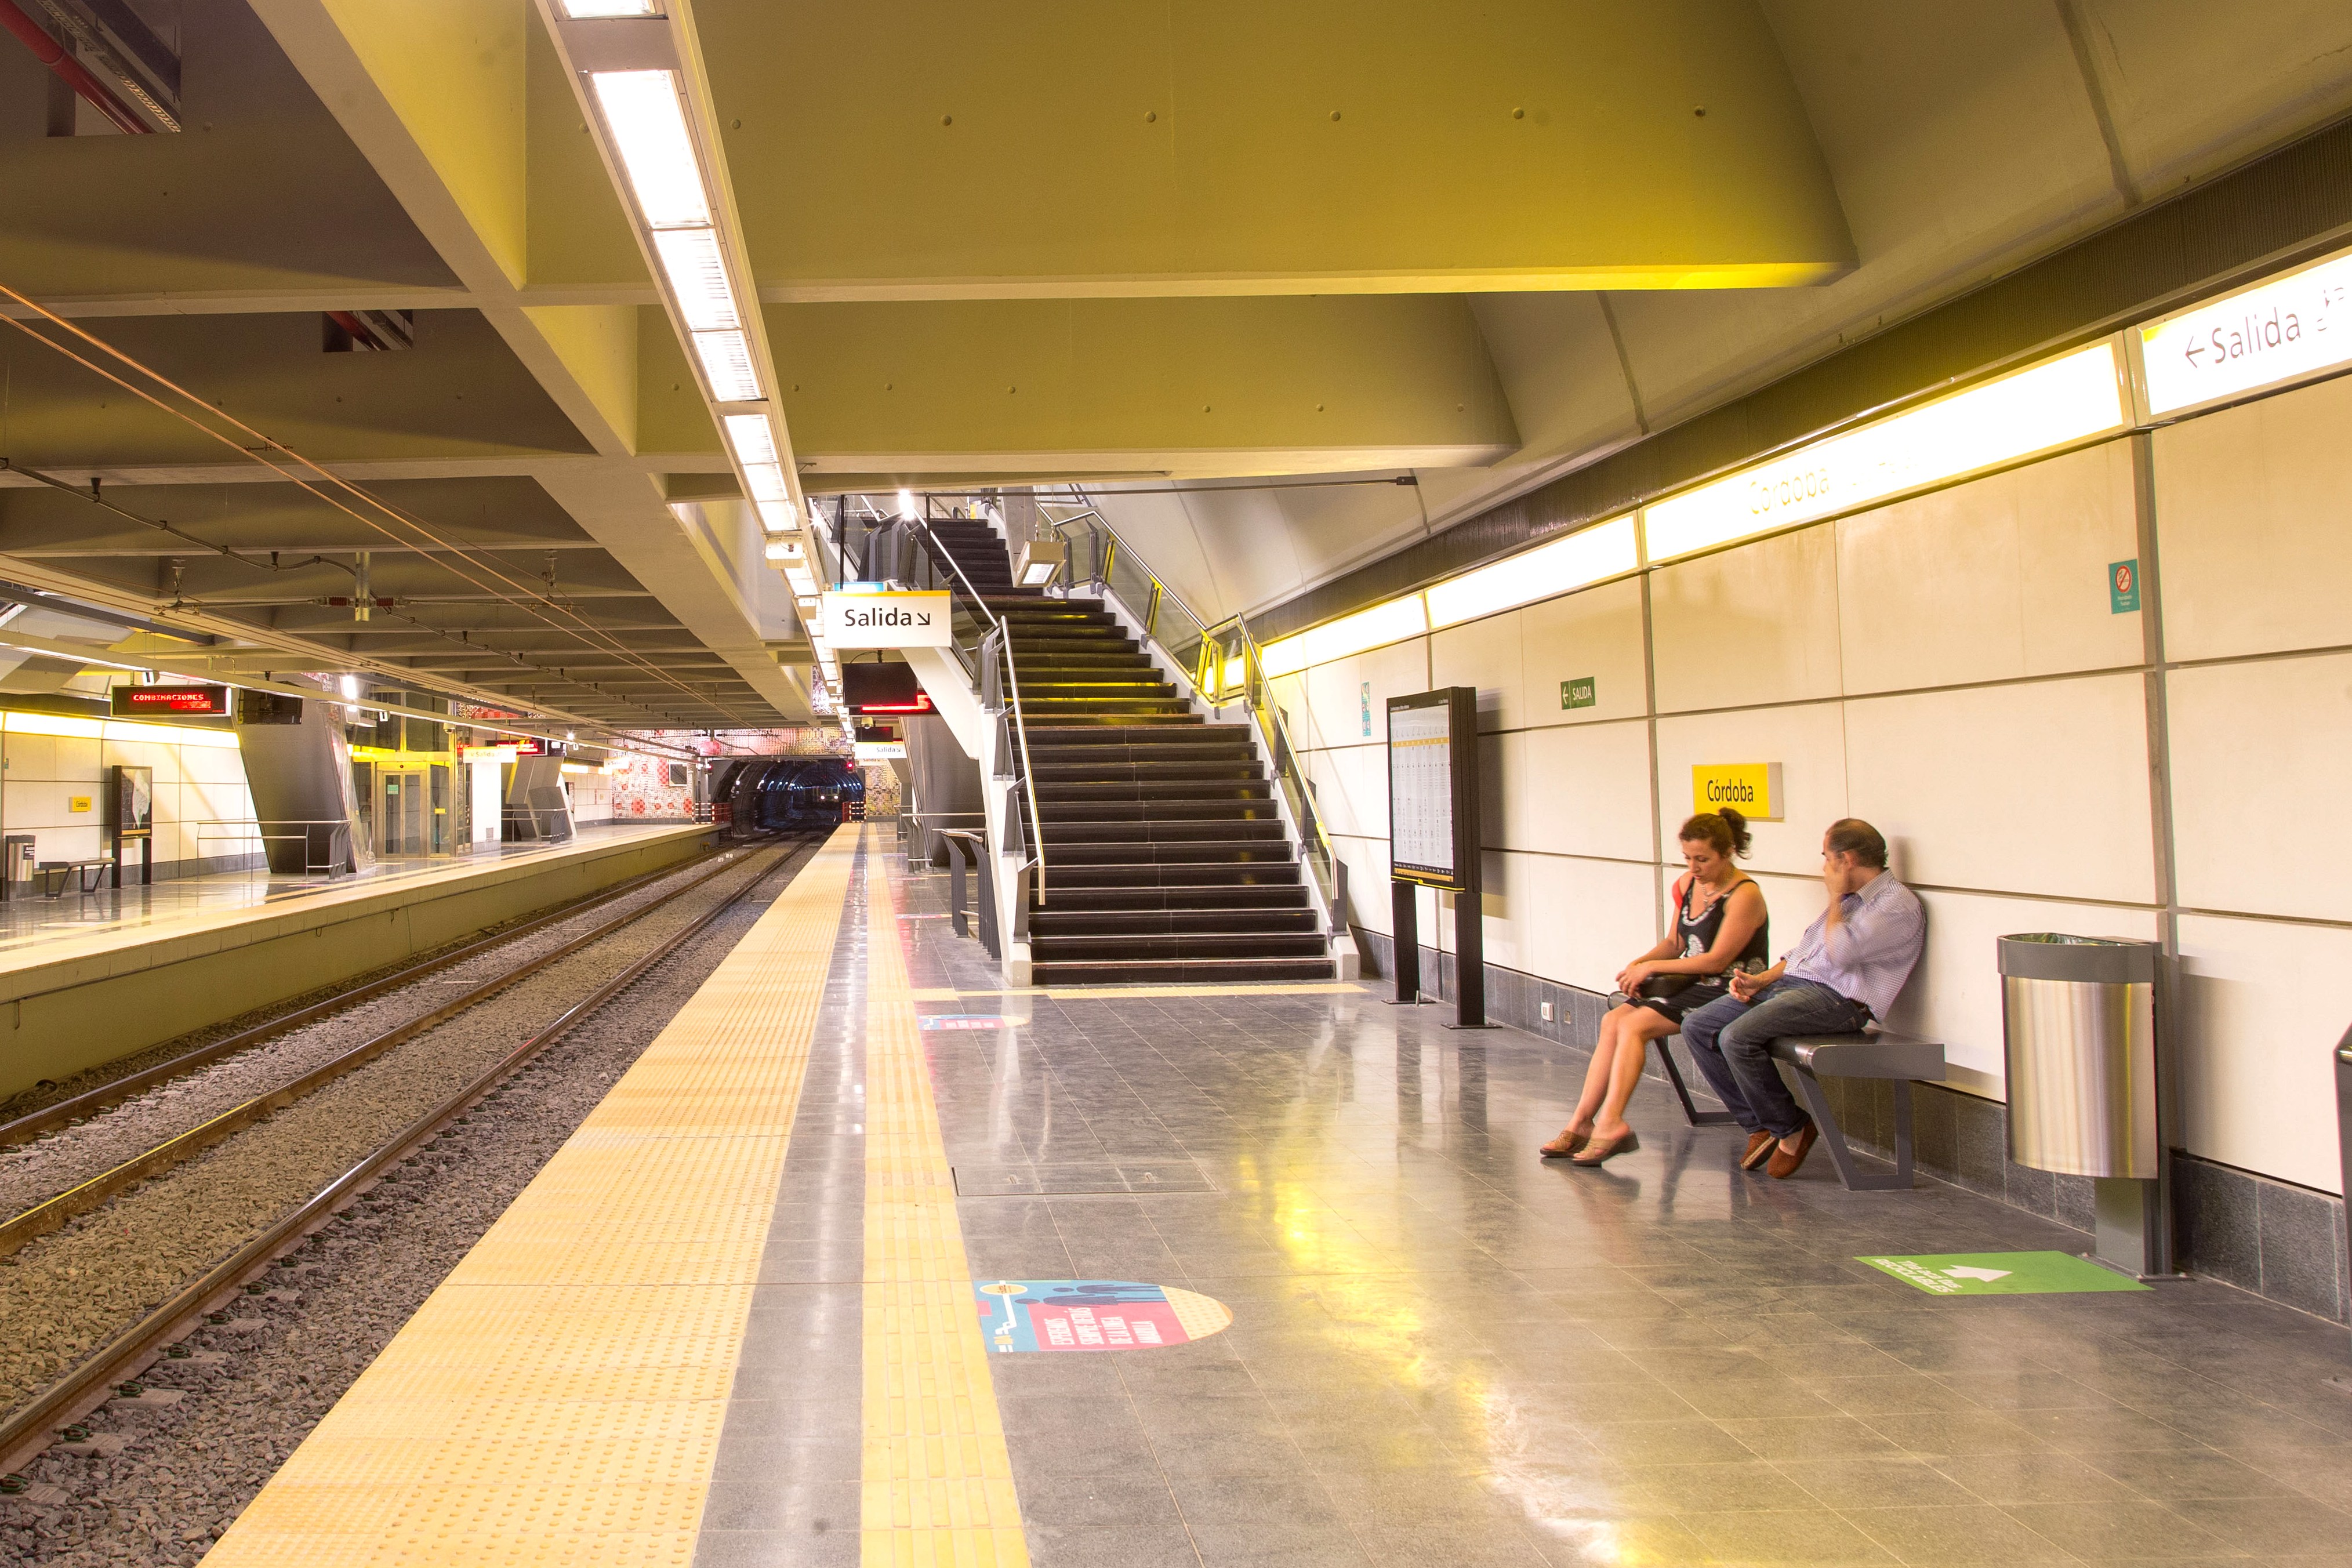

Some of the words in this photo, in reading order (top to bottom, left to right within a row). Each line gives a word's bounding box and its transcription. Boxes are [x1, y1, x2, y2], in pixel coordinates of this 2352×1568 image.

[2212, 306, 2301, 364] Salida
[845, 607, 912, 627] Salida
[1573, 685, 1592, 700] SALIDA
[1707, 778, 1754, 802] Córdoba
[1044, 1317, 1075, 1345] ESPEREMOS
[1130, 1320, 1163, 1344] AMARILLA
